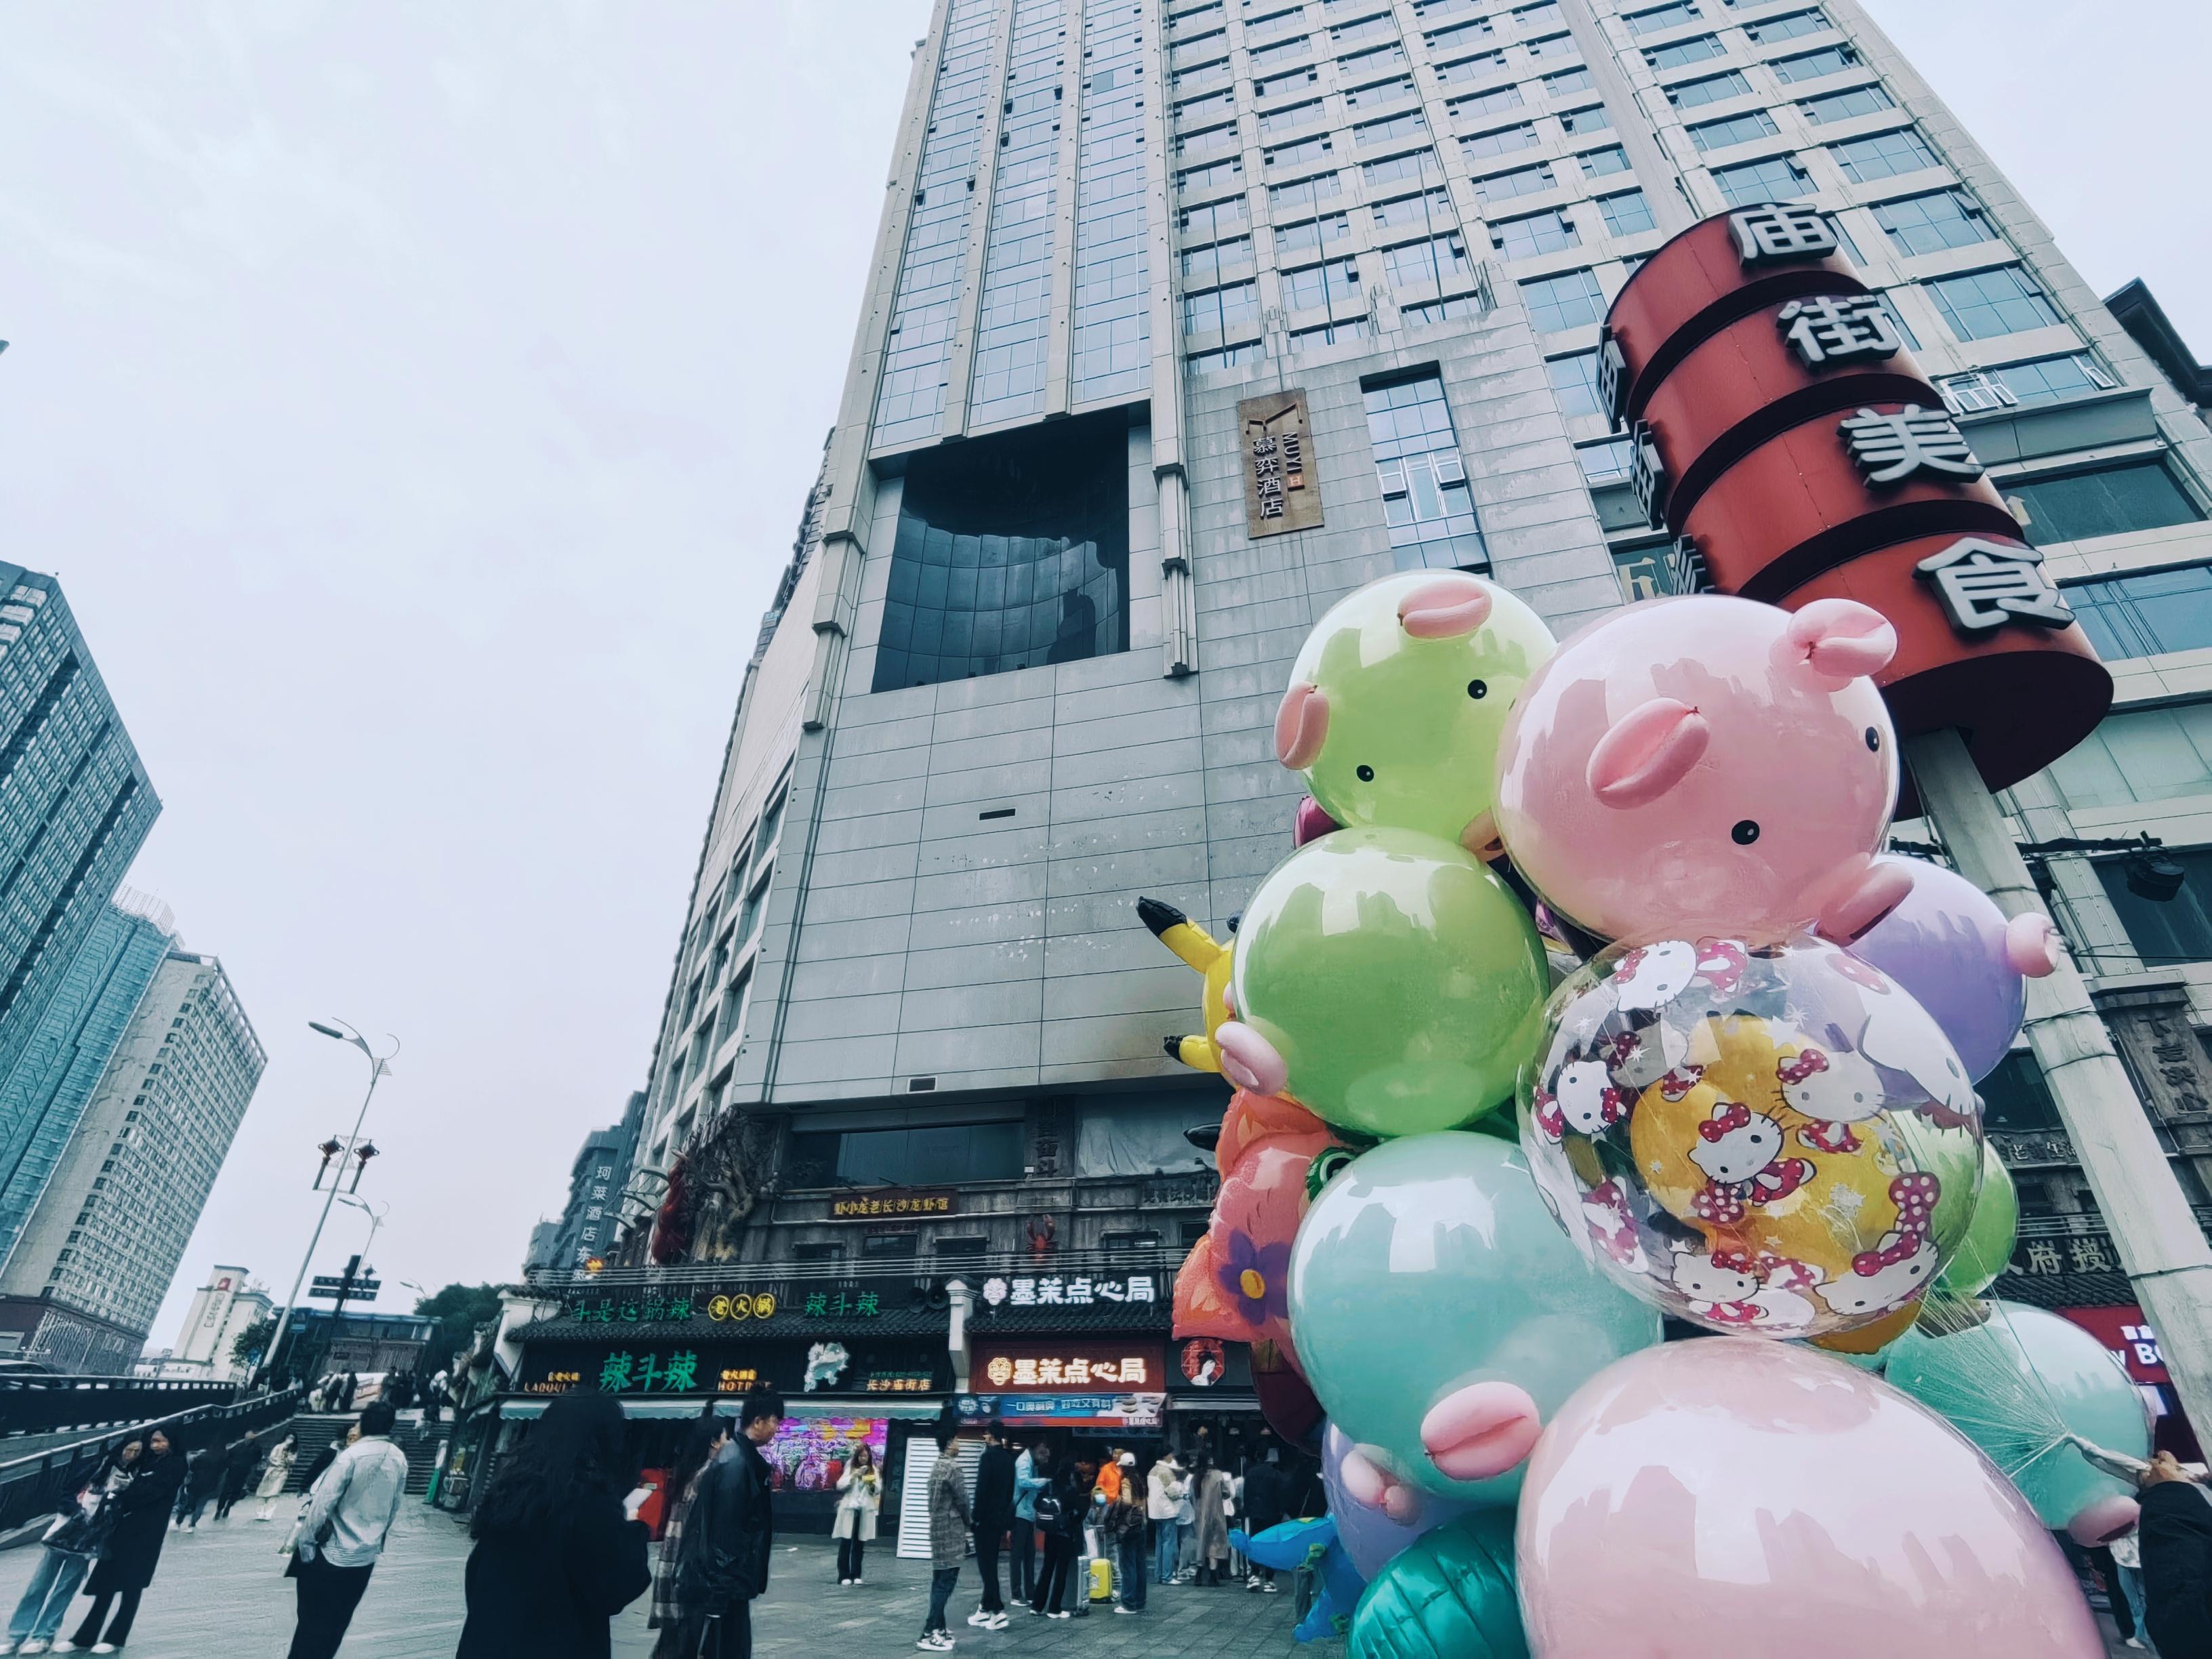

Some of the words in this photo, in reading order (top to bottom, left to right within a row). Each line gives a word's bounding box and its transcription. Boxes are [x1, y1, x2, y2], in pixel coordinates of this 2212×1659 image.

[1729, 203, 2076, 630] 庙街美食
[1282, 432, 1302, 474] MUYI
[1253, 436, 1284, 519] 慕弈酒店
[710, 1295, 777, 1319] 老火锅
[804, 1290, 879, 1317] 辣斗辣
[1010, 1276, 1155, 1305] 墨茉点心局
[598, 1350, 697, 1393] 辣斗辣
[1012, 1357, 1147, 1385] 墨茉点心局
